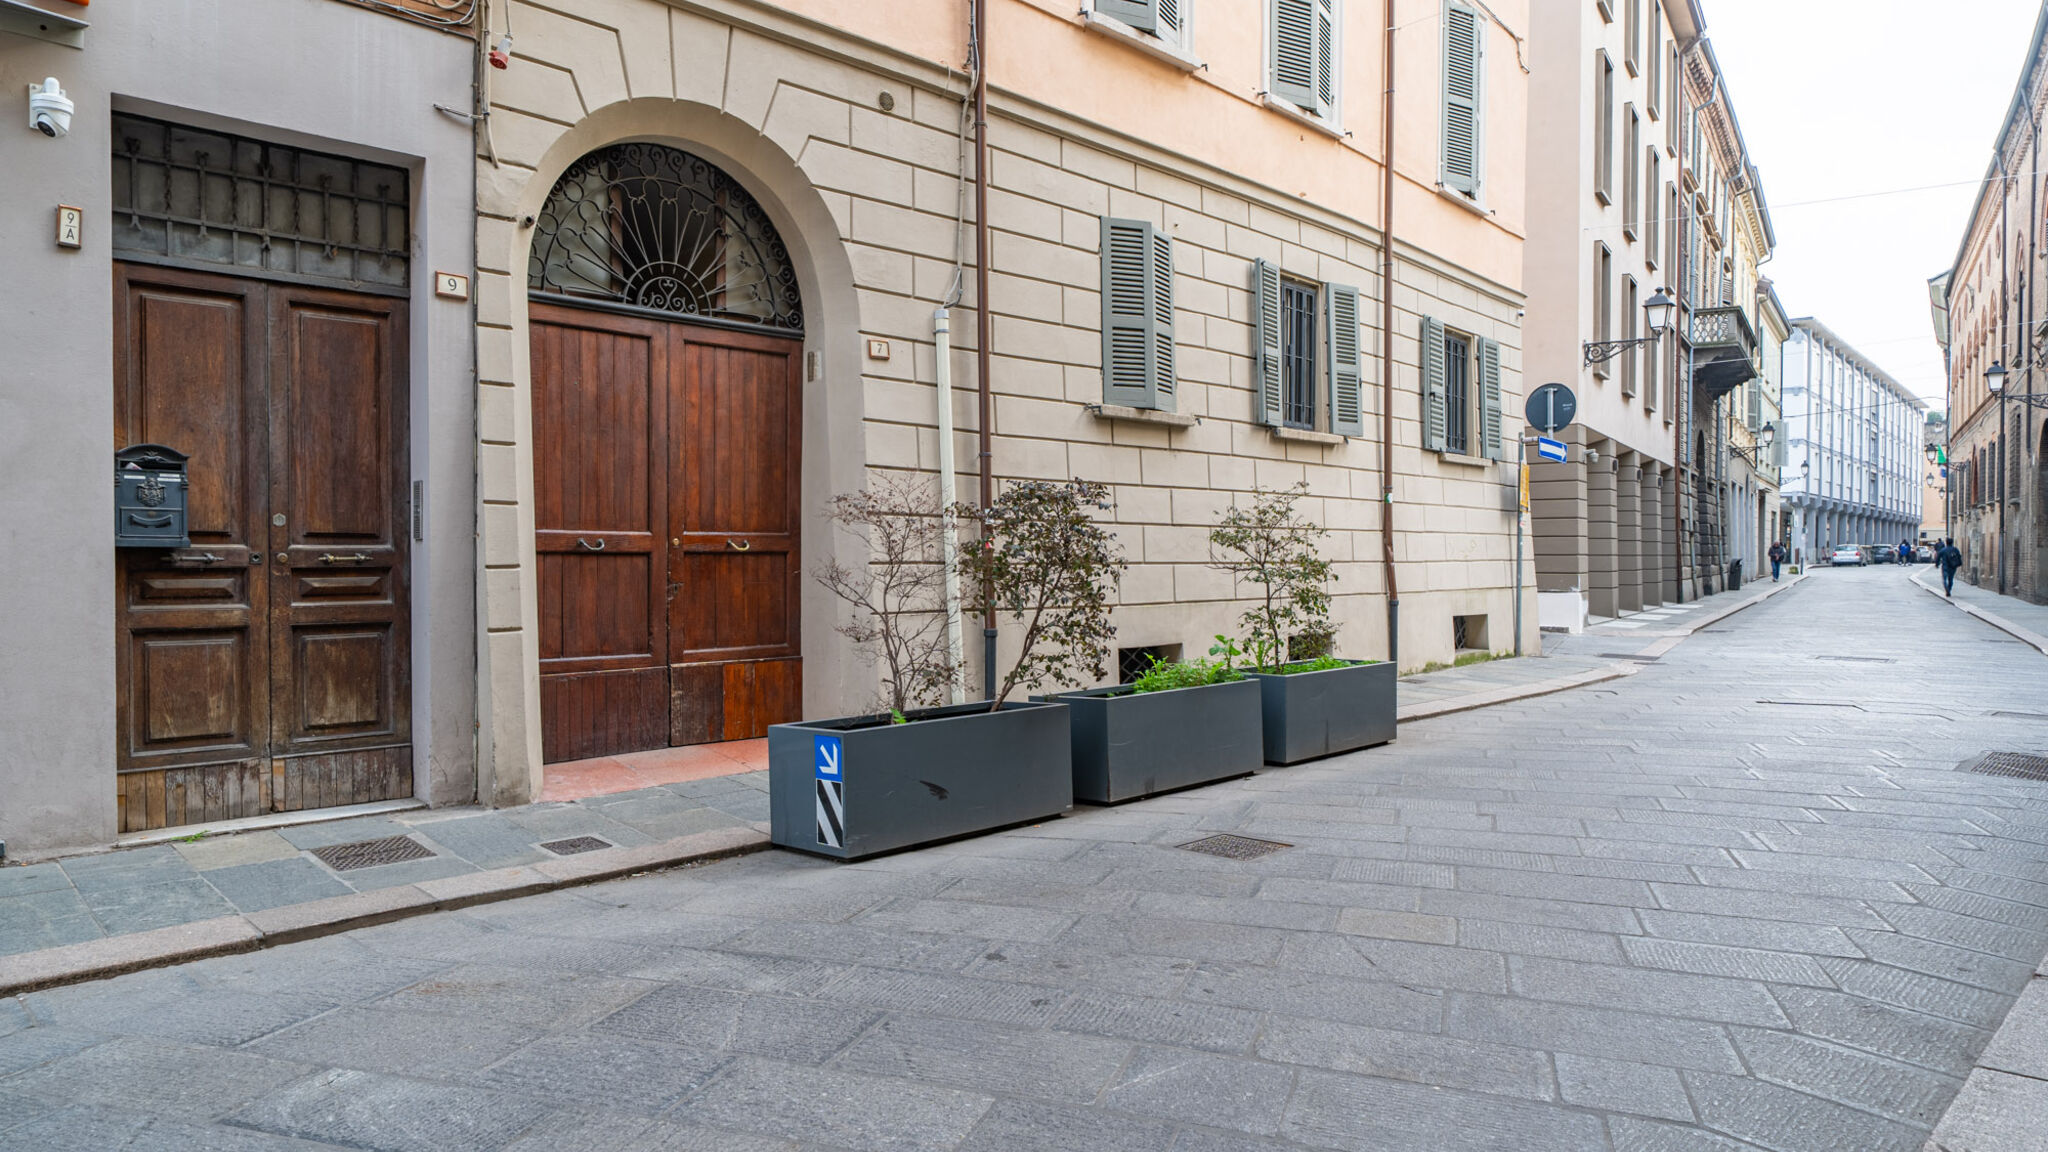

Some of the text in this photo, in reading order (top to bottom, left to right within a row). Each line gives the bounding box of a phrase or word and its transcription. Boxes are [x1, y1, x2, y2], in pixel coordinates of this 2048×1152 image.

[67, 211, 75, 224] 9
[66, 228, 75, 240] A
[448, 278, 457, 291] 9
[877, 343, 883, 354] 7
